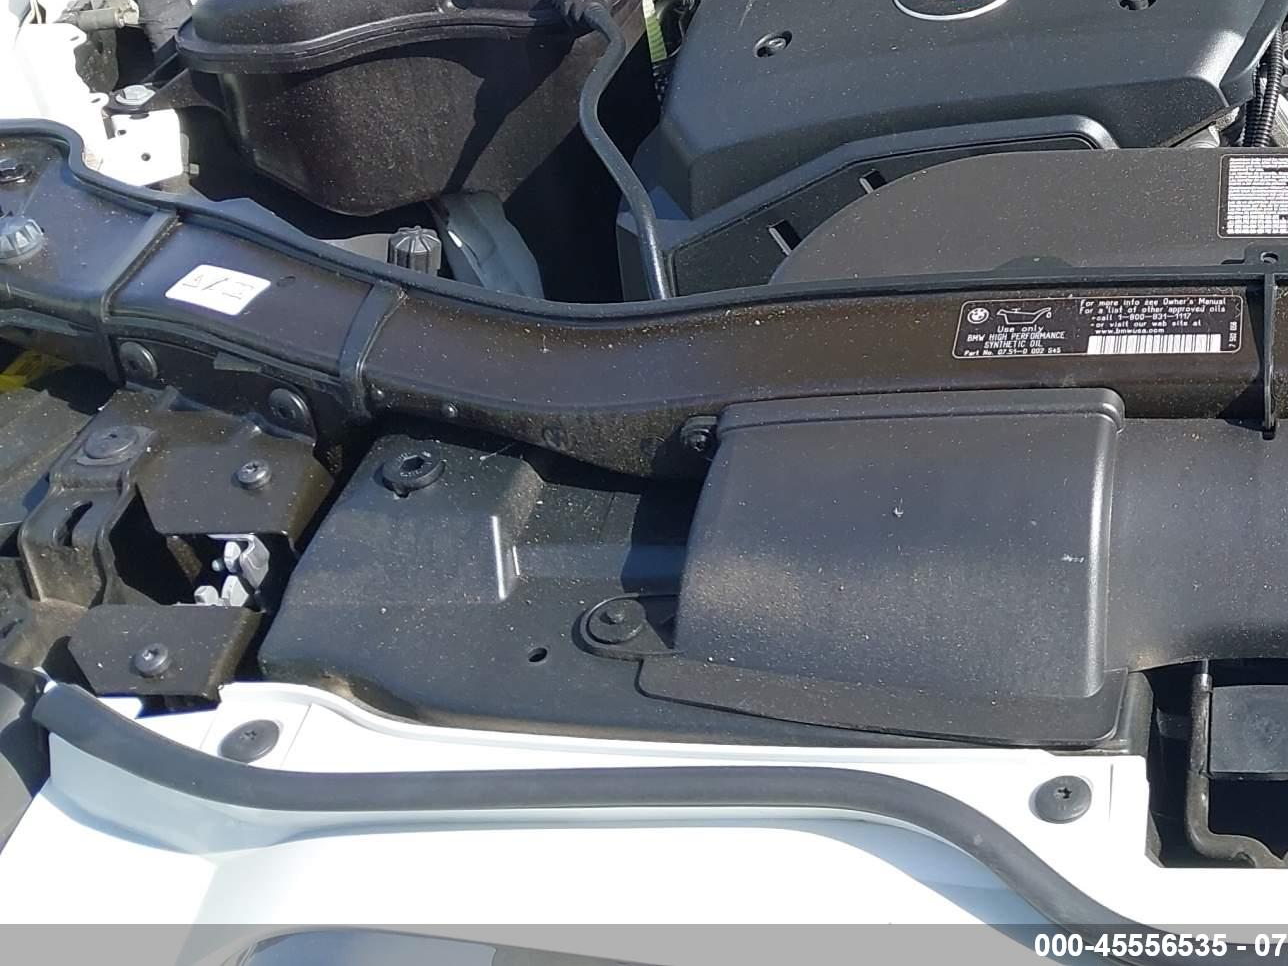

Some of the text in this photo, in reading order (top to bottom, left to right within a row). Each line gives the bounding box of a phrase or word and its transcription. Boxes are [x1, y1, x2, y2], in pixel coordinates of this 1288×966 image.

[1080, 299, 1095, 307] For
[1168, 306, 1205, 314] approved
[1021, 324, 1044, 334] only
[967, 331, 1066, 342] BMW HIGH PERFORMANCE
[984, 339, 1043, 348] SYNTHETIC OIL
